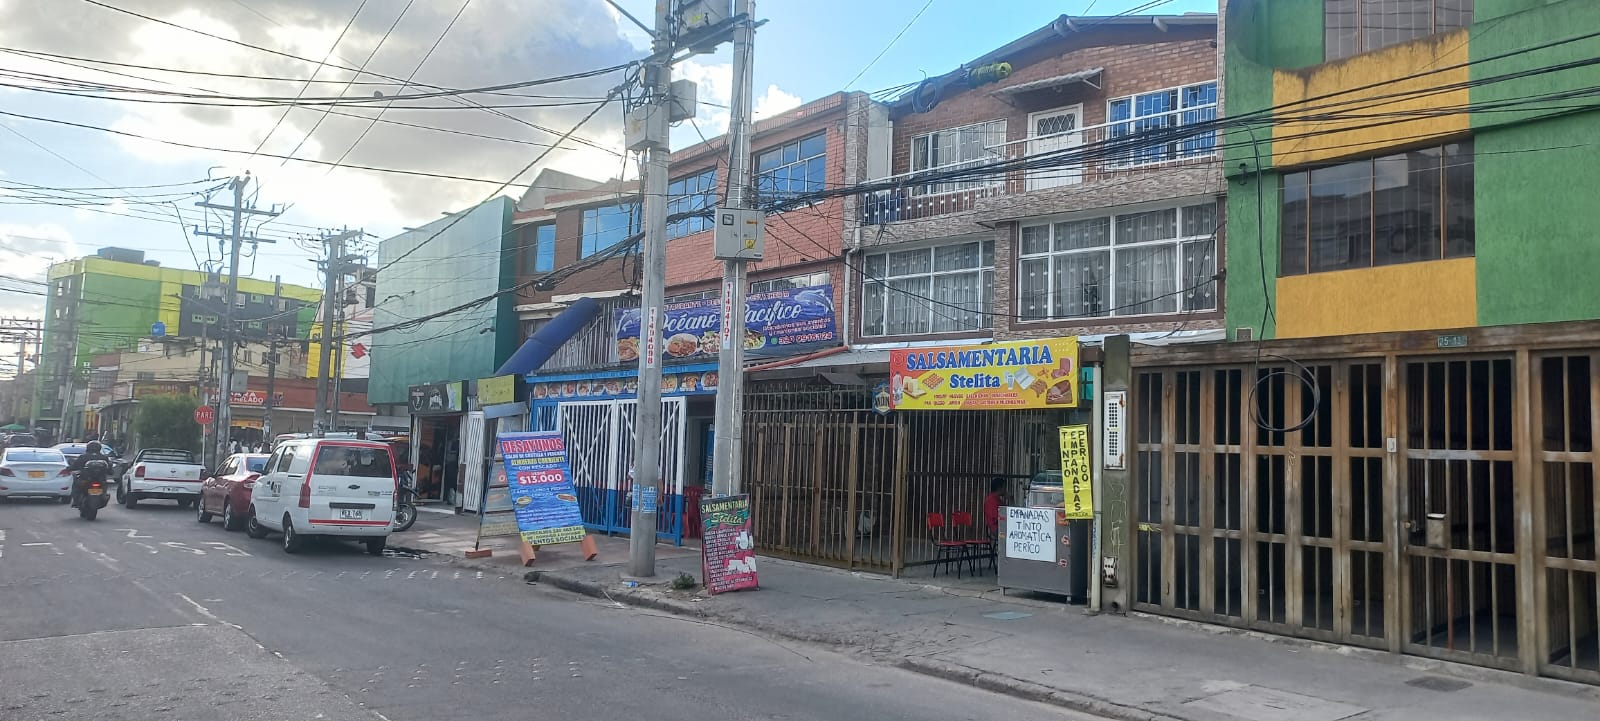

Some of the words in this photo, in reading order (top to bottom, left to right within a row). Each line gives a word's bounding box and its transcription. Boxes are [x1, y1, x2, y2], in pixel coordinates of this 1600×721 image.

[906, 345, 1053, 371] SALSAMENTARIA
[949, 373, 1000, 389] Stelita
[502, 439, 565, 454] DESAYUNOS
[1061, 431, 1071, 478] TINTO
[1078, 430, 1089, 482] PERICO
[1070, 430, 1081, 511] EMPANADAS
[520, 474, 562, 485] $13.000
[701, 499, 748, 514] SALSAMENTARIA
[1009, 508, 1049, 523] EMPANADAS
